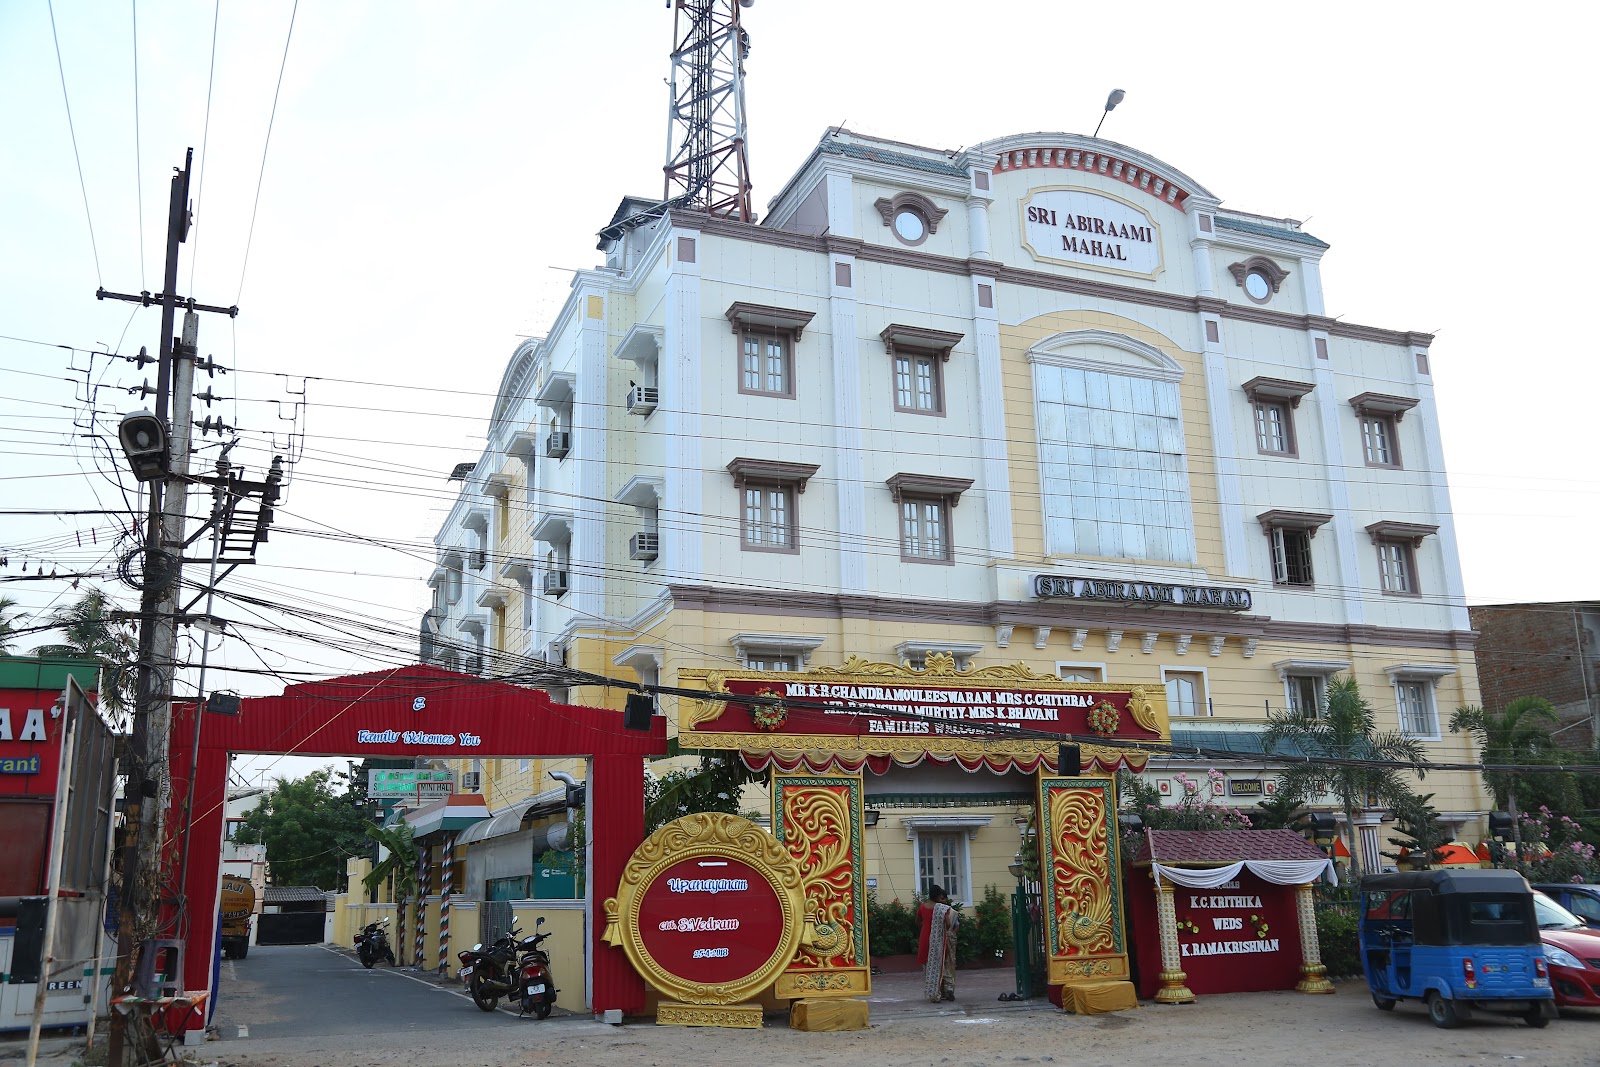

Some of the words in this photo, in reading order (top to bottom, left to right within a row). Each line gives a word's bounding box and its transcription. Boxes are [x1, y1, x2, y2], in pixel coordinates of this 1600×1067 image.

[1028, 206, 1057, 226] SRI
[1065, 213, 1153, 243] ABIRAAMI
[1062, 234, 1127, 261] MAHAL
[1039, 577, 1075, 597] SRI
[1080, 580, 1176, 603] ABIRAAMI
[1182, 587, 1248, 606] MAHAL
[413, 697, 426, 711] &
[868, 719, 930, 734] FAMILIES
[357, 729, 401, 744] Family
[402, 730, 456, 745] Welcomes
[458, 732, 481, 746] You
[0, 757, 37, 771] ant
[1231, 782, 1260, 792] WELCOME
[1212, 917, 1243, 931] WEDS
